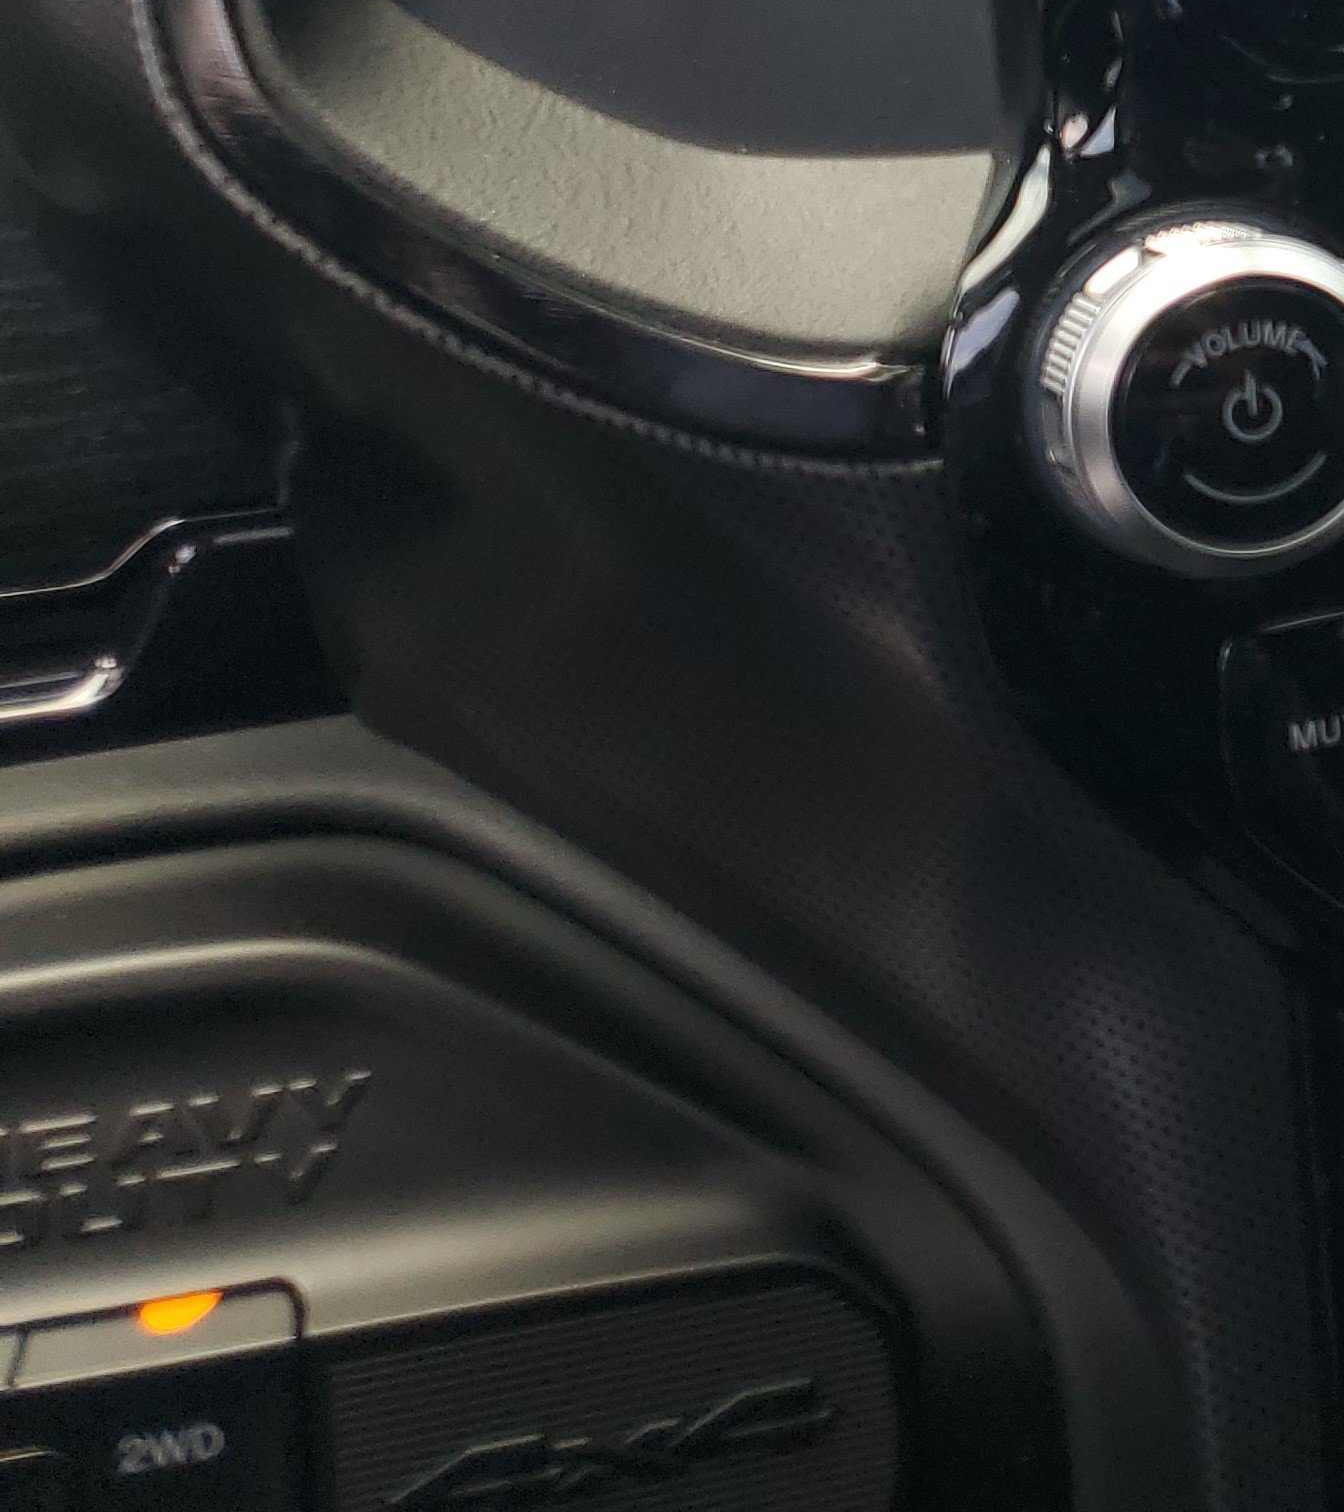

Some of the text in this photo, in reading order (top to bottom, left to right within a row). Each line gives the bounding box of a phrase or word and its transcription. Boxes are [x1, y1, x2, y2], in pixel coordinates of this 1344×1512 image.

[1187, 321, 1304, 368] VOLUME
[0, 1071, 373, 1182] EAVY
[116, 1420, 226, 1475] 2WD
